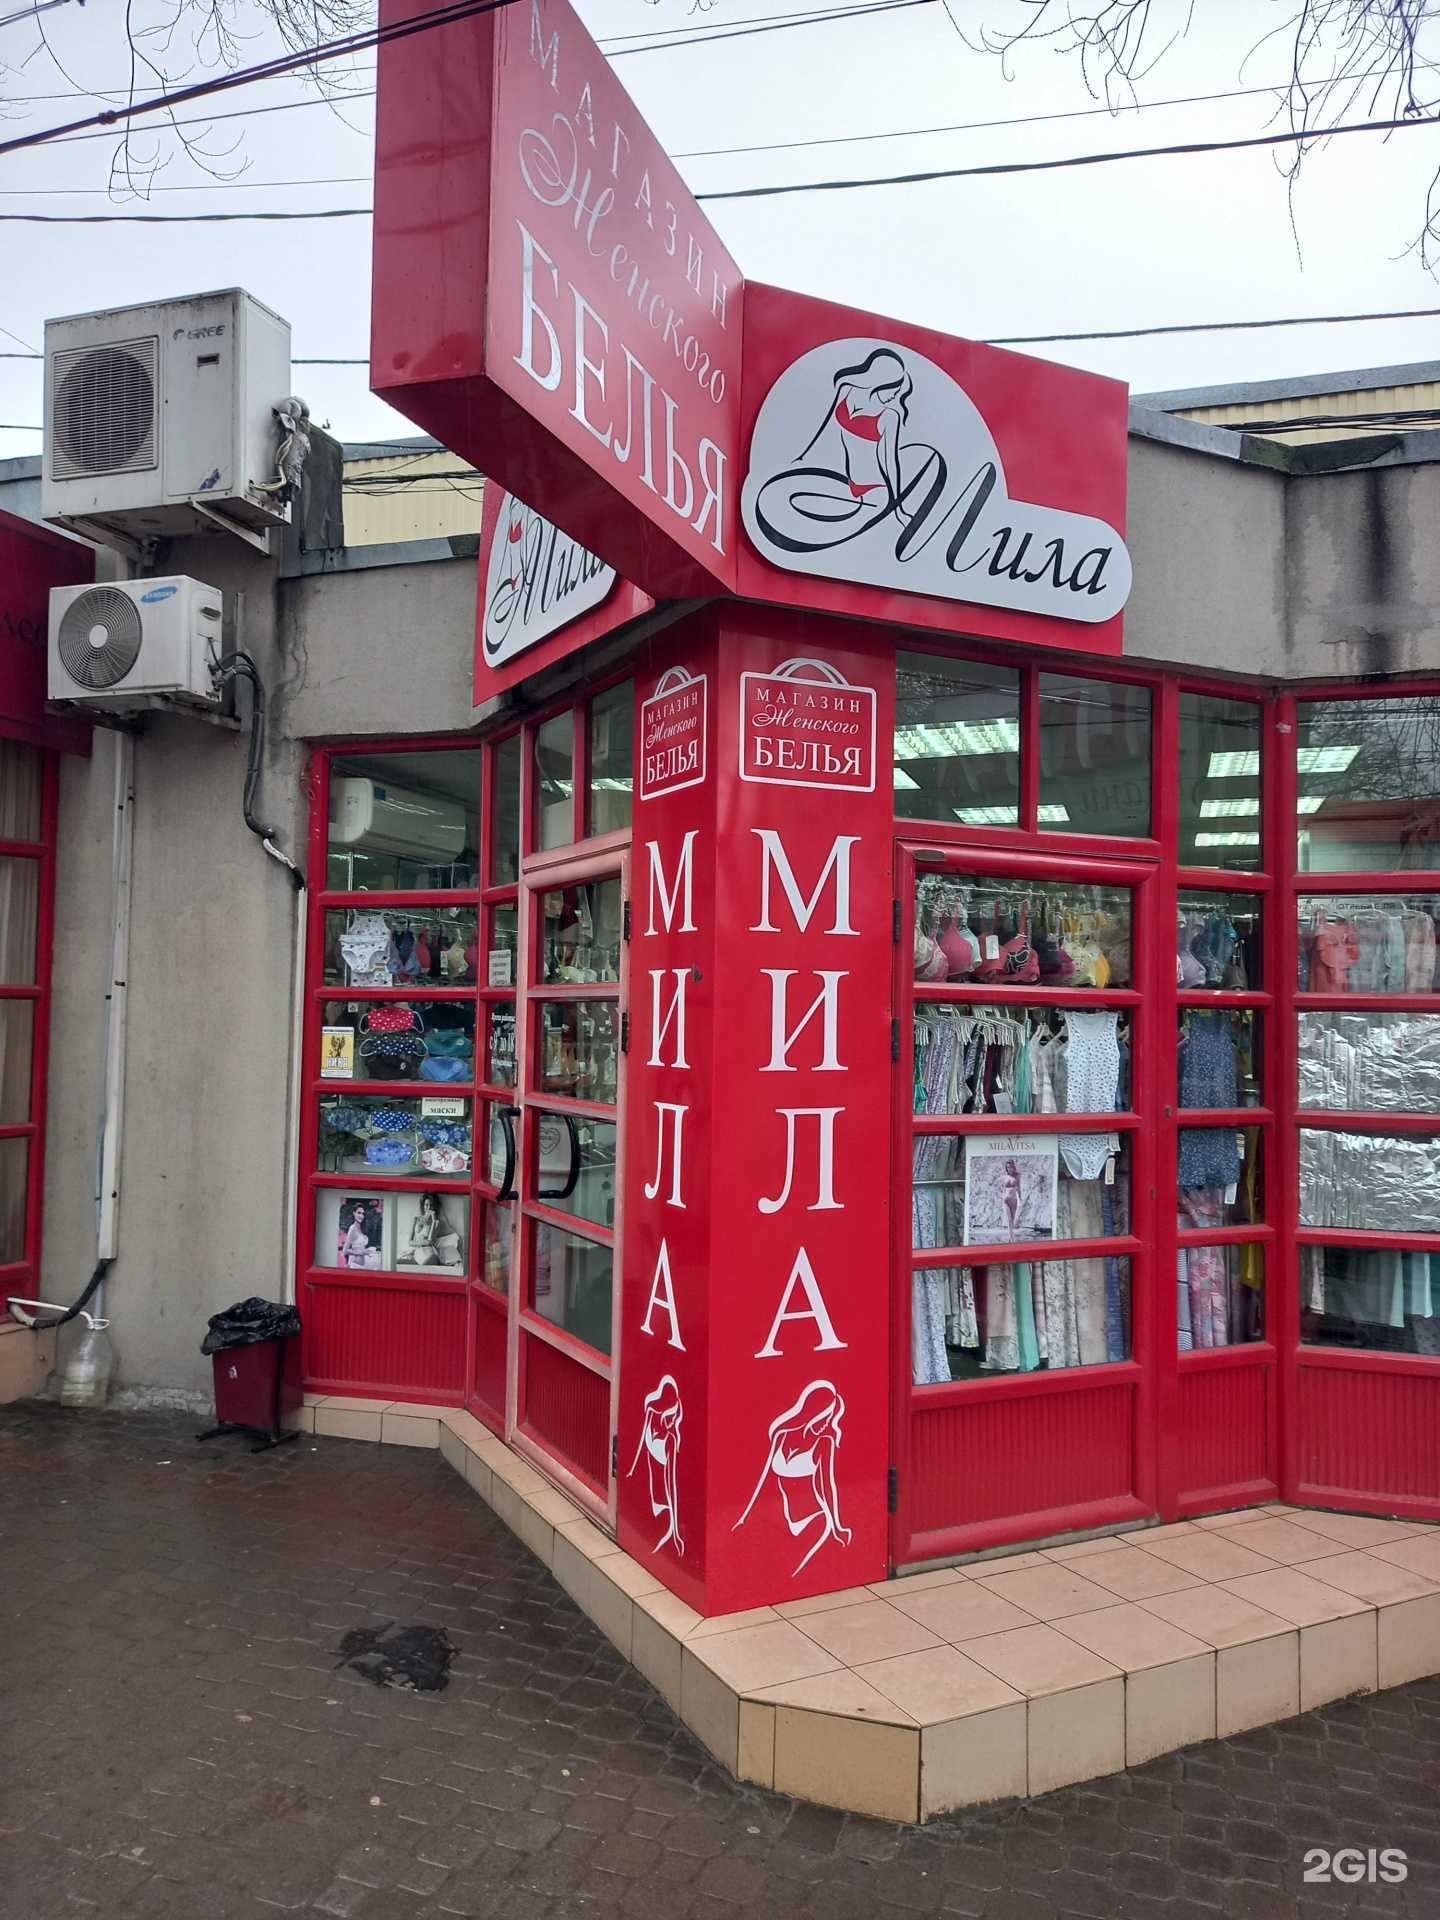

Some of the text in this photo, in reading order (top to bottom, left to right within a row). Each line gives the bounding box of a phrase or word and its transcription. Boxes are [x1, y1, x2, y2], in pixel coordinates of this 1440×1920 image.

[529, 0, 727, 330] МАГАЗИН
[519, 112, 726, 403] Женского
[512, 218, 727, 556] БЕЛЬЯ
[755, 443, 1113, 595] Мила
[646, 715, 697, 749] Женского
[647, 691, 698, 725] МАГАЗИН
[752, 704, 859, 735] Женского
[756, 688, 861, 713] МАГАЗИН
[646, 739, 698, 785] БЕЛЬЯ
[753, 736, 862, 776] БЕЛЬЯ
[640, 830, 699, 1353] МИЛА
[748, 828, 862, 1359] МИЛА
